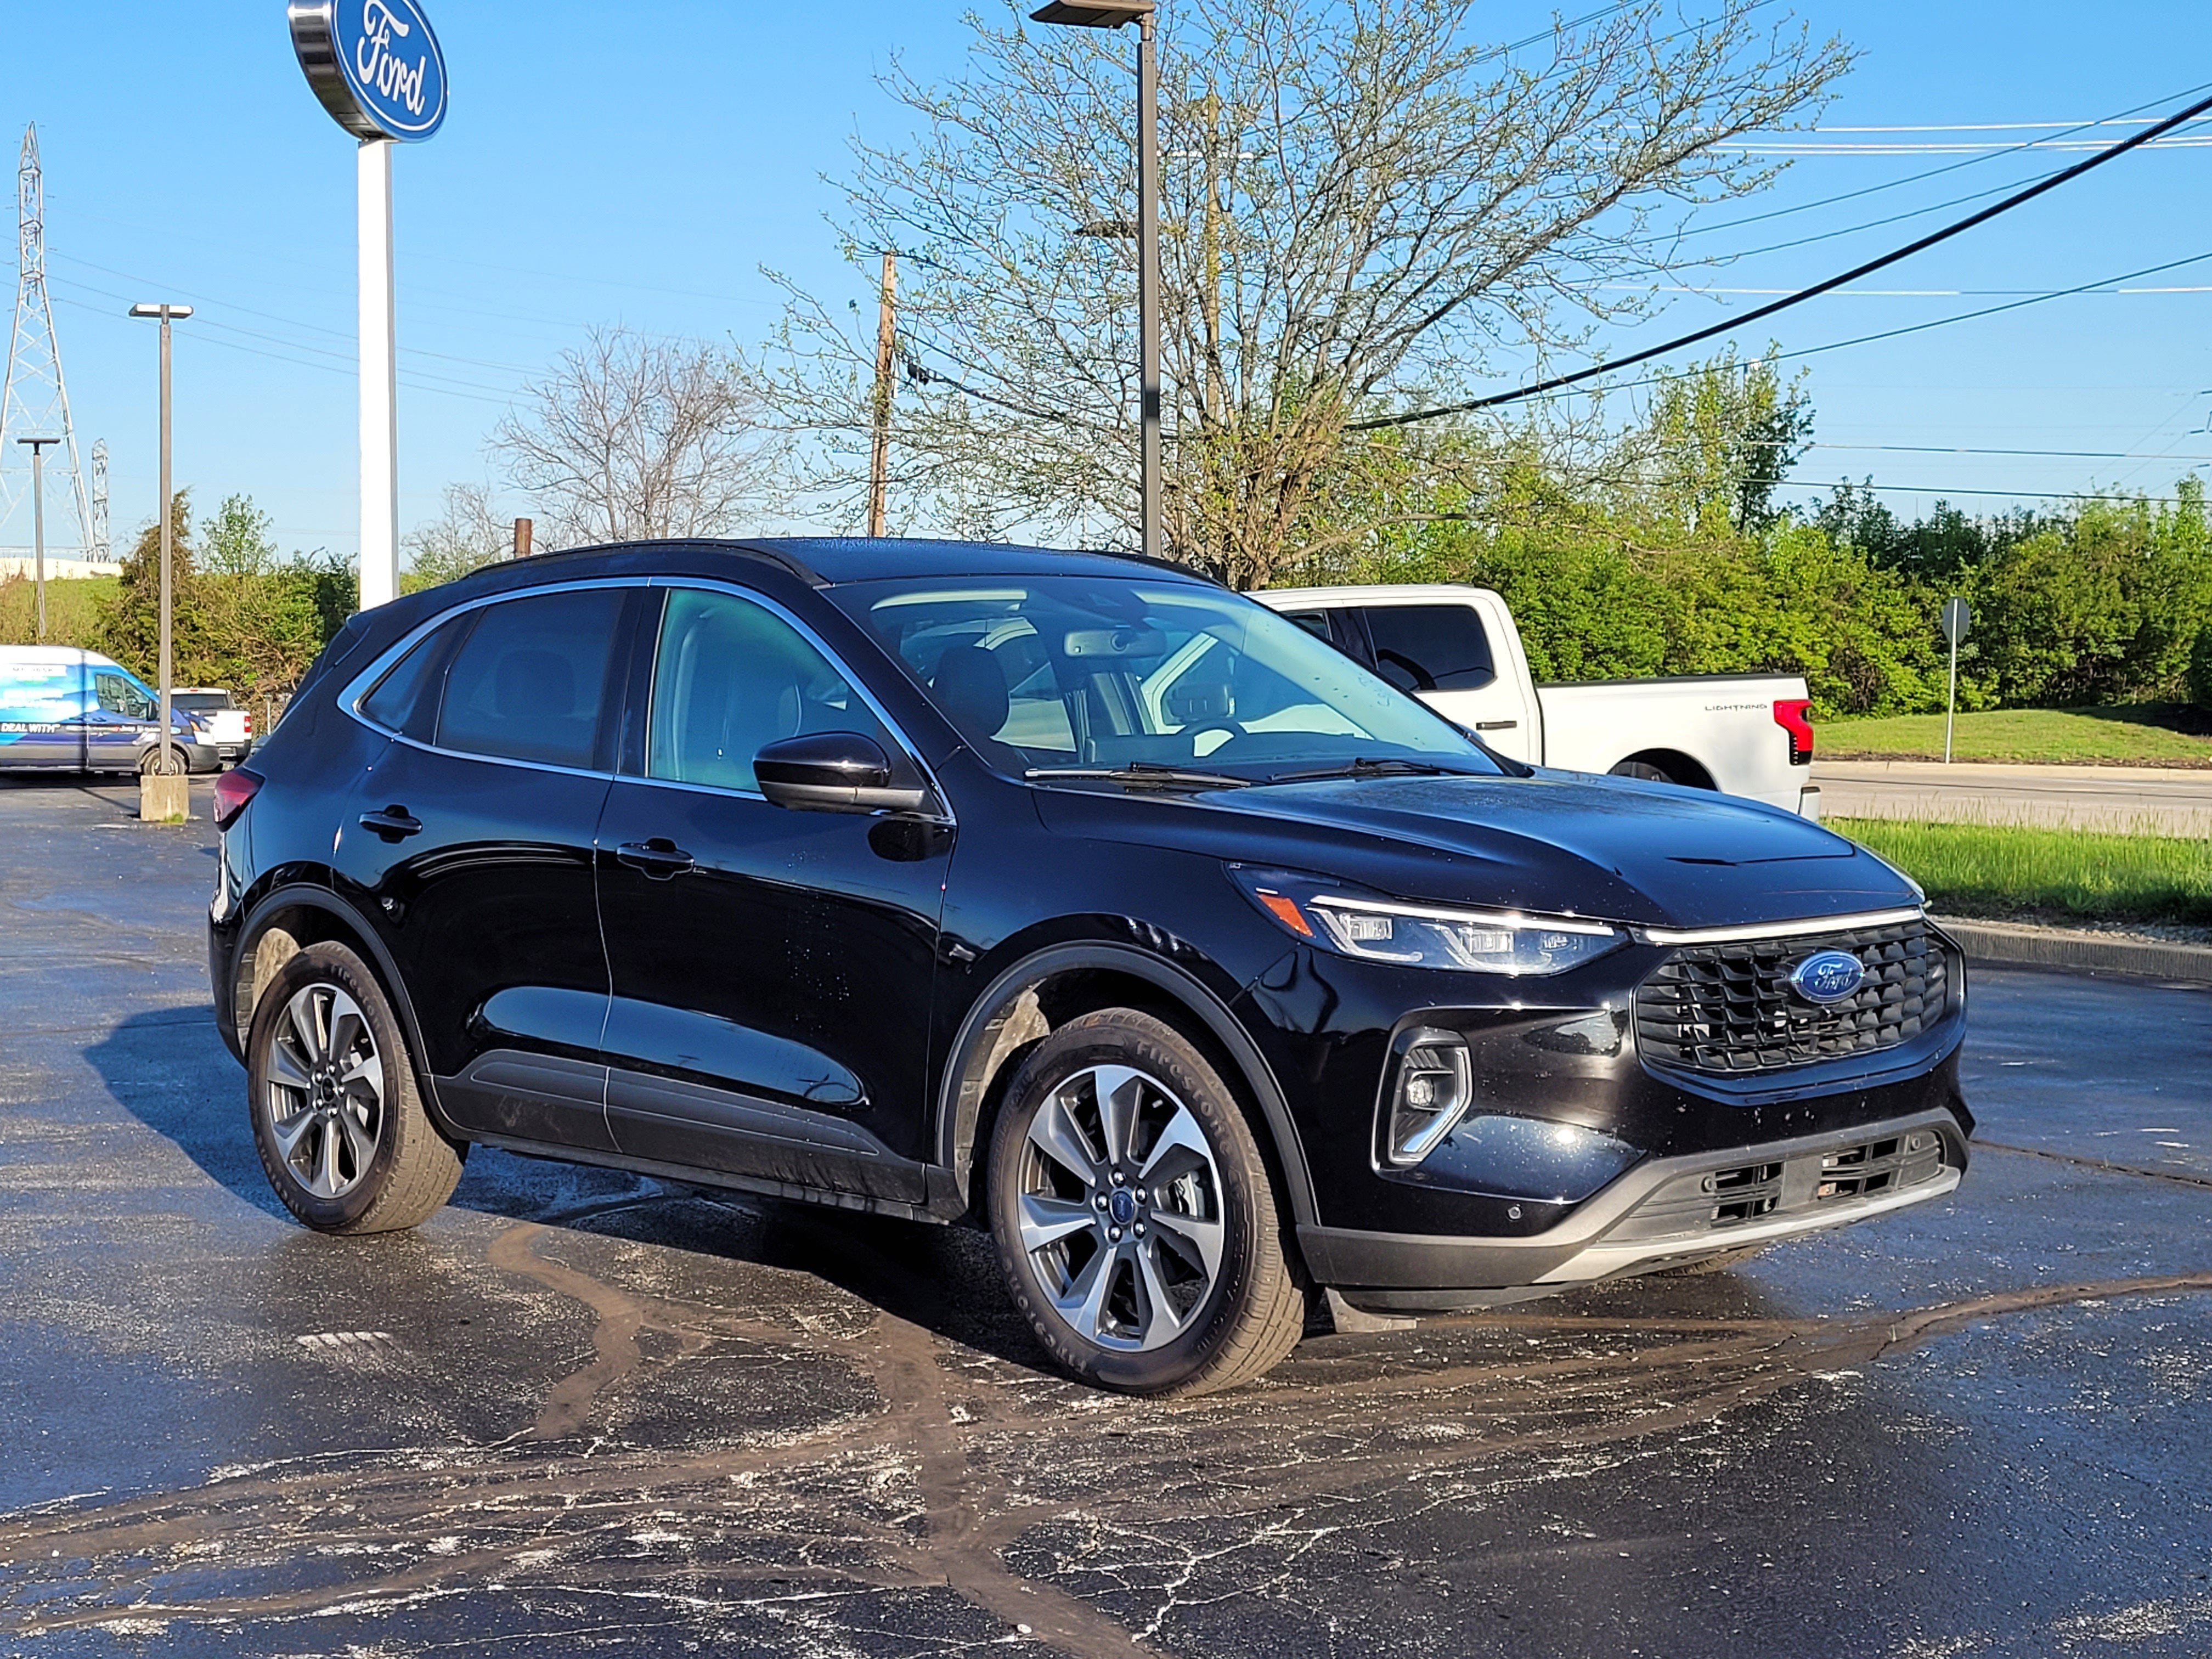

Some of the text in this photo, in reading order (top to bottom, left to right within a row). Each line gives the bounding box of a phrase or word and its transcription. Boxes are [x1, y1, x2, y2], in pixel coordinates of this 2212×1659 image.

[357, 0, 426, 116] Ford
[1705, 703, 1768, 712] LIGHTNING
[1, 723, 28, 732] DEAL
[29, 724, 57, 733] WITH
[1814, 962, 1853, 991] Ford
[1137, 1041, 1233, 1155] Firestone
